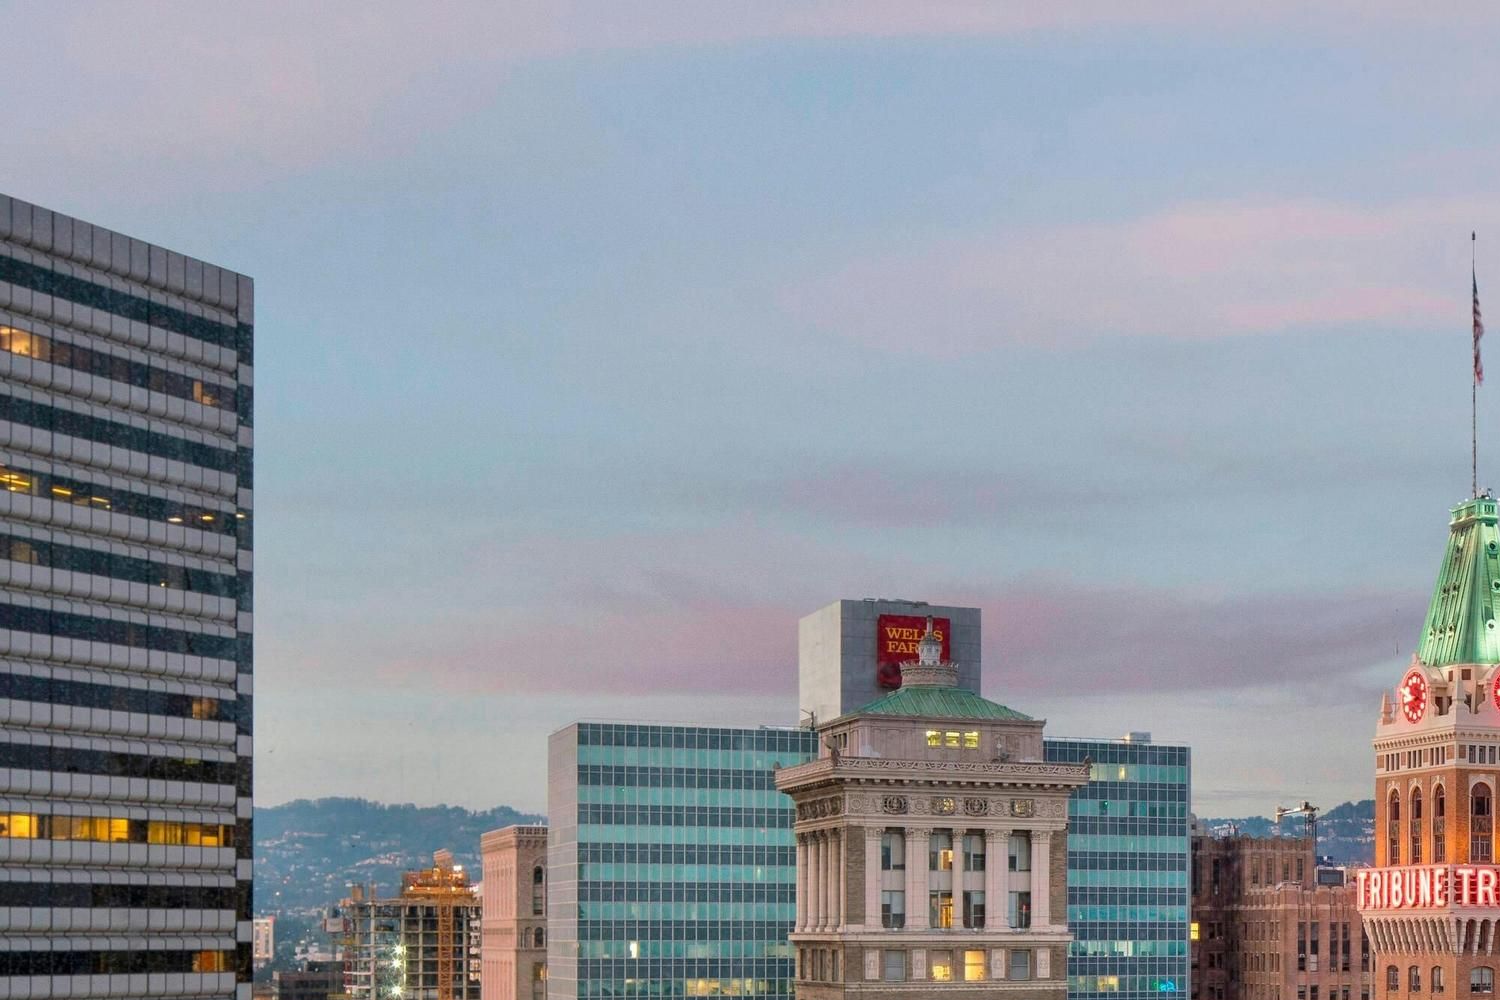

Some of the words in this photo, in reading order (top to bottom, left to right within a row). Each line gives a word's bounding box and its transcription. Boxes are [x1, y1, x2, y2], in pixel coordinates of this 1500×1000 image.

[885, 627, 944, 642] WELS
[886, 641, 921, 654] FAR
[1358, 868, 1446, 908] TRIBUNE
